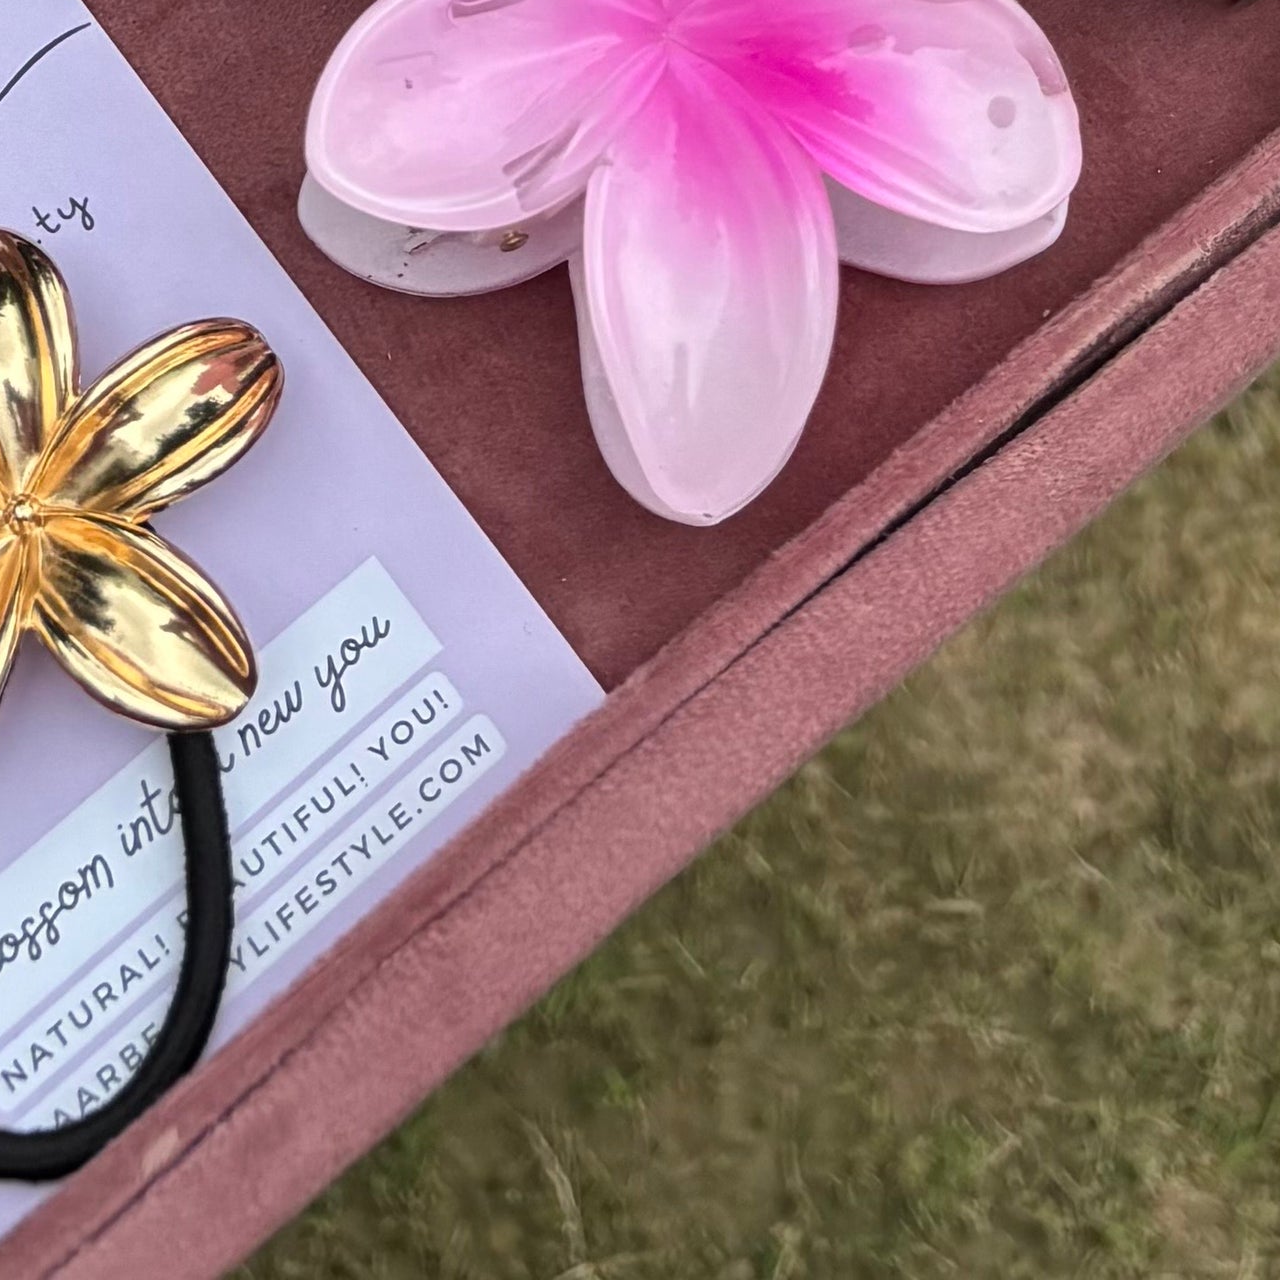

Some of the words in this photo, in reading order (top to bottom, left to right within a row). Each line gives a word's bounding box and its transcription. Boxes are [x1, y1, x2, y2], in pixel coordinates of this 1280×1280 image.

[236, 679, 304, 737] new
[313, 615, 391, 714] you
[0, 933, 171, 1093] NATURAL!
[366, 689, 450, 762] YOU!
